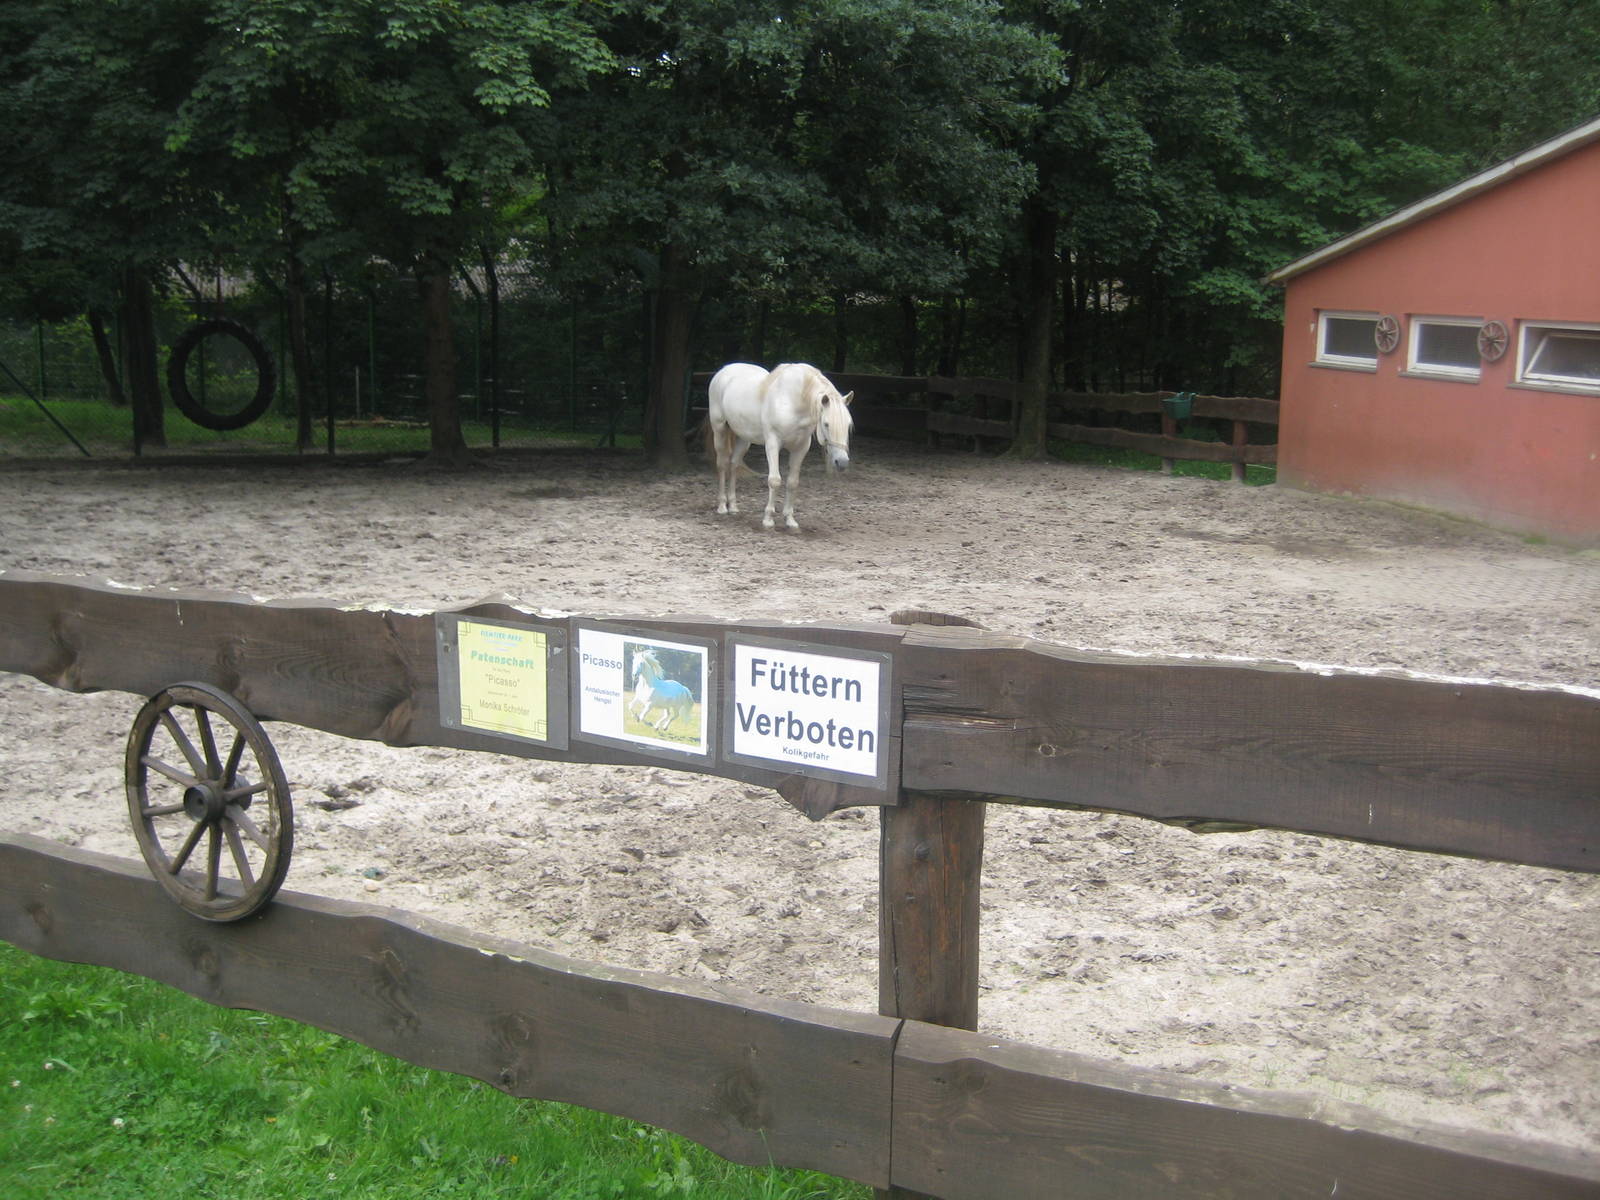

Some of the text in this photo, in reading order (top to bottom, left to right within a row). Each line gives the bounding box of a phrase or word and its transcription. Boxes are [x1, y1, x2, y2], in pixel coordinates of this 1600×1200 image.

[470, 650, 535, 669] Patenschaft
[582, 653, 623, 670] Picasso
[751, 658, 862, 703] Füttern
[736, 702, 874, 753] Verboten
[782, 746, 830, 761] Kolikgefahr
